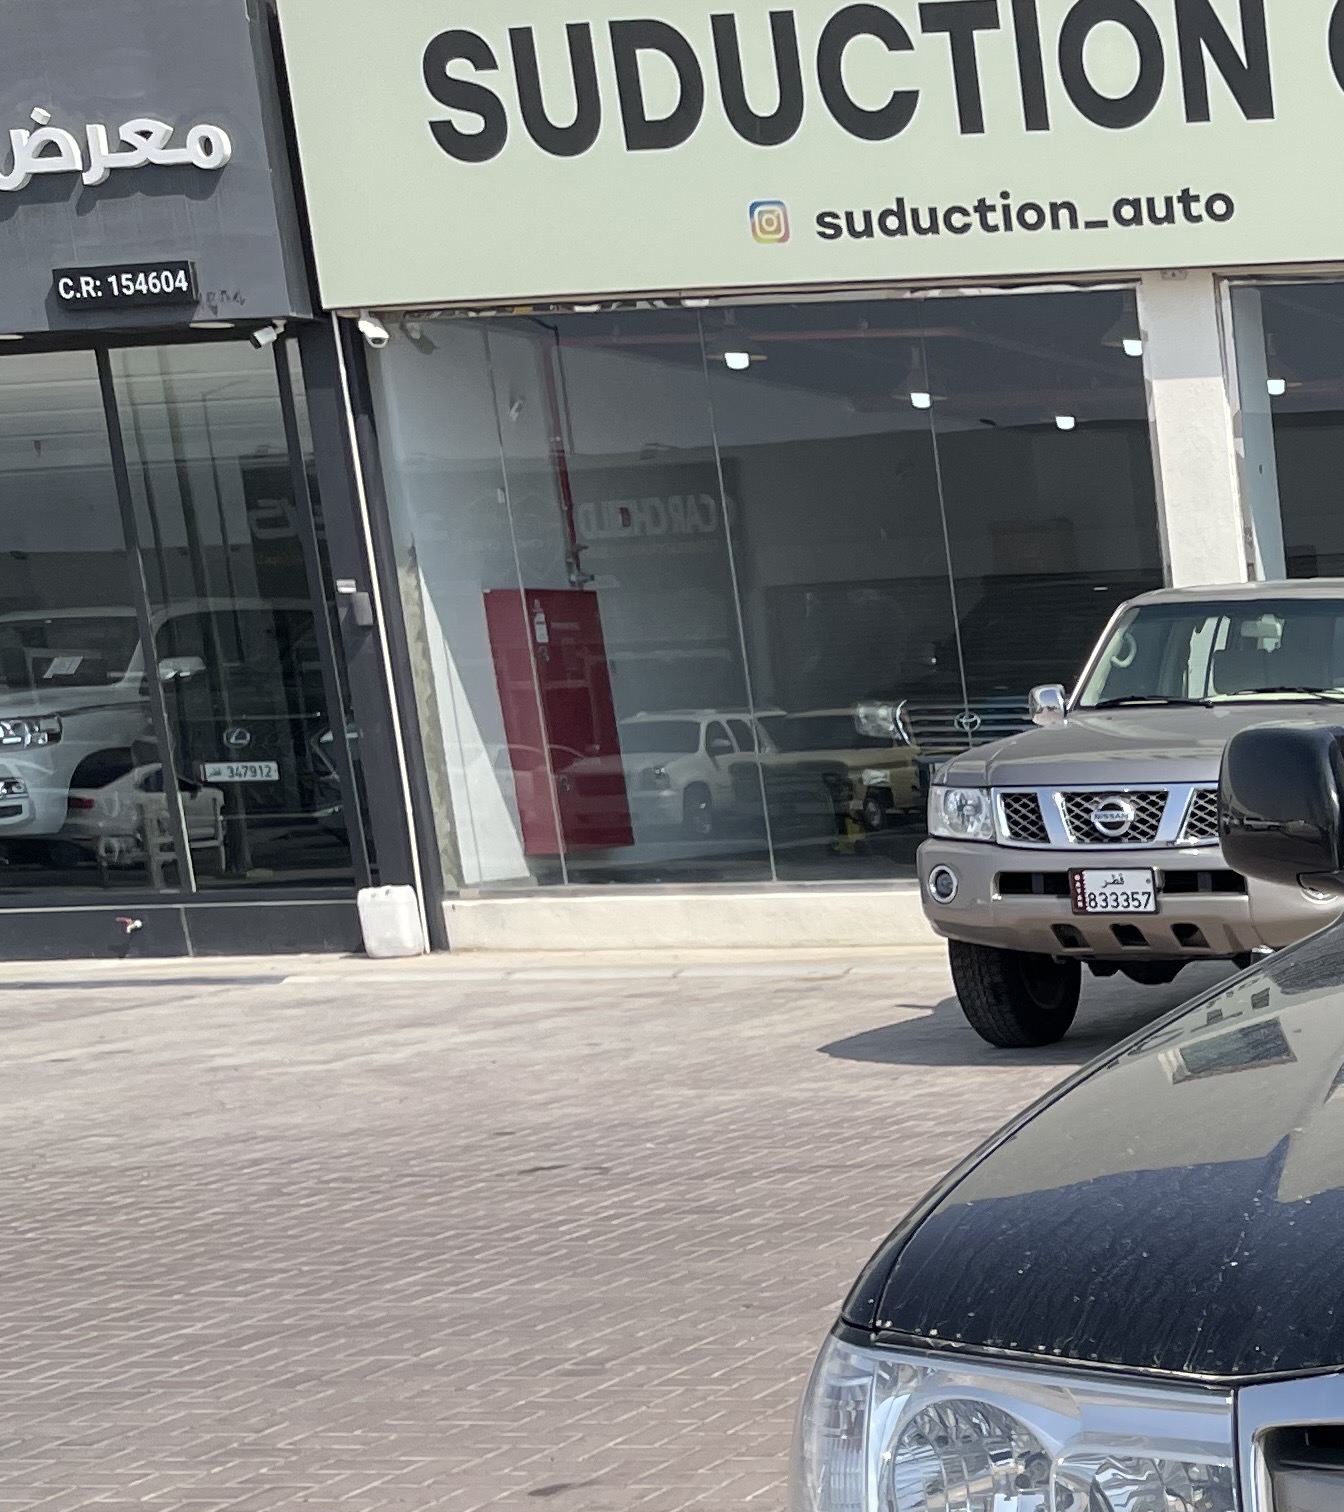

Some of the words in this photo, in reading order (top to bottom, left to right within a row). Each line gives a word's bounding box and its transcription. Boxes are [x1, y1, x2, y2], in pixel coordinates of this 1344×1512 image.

[421, 0, 1276, 164] SUDUCTION
[0, 106, 232, 191] معرض
[815, 185, 1236, 242] suduction_auto
[58, 274, 103, 300] C.R:
[107, 269, 189, 296] 154604
[1087, 891, 1152, 909] 833357
[1101, 872, 1125, 889] قطر
